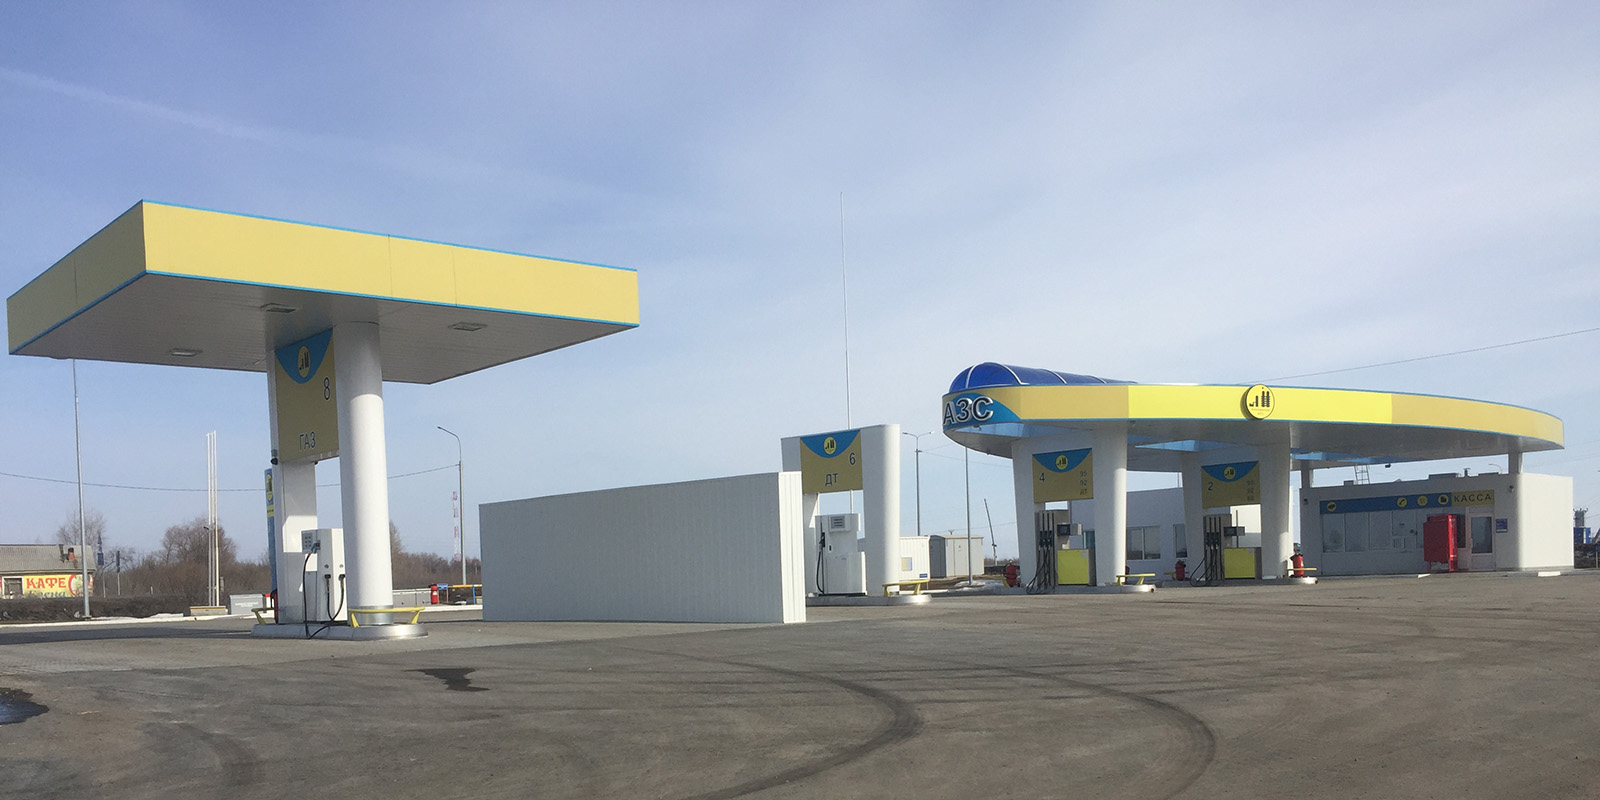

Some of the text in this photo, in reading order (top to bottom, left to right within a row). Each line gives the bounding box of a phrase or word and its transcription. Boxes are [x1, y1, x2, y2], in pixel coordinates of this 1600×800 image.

[323, 376, 331, 401] 8
[943, 395, 994, 426] АЗС
[299, 431, 316, 451] ГАЗ
[849, 452, 856, 466] 6
[824, 472, 839, 486] ДТ
[1039, 472, 1046, 483] 4
[1207, 481, 1214, 491] 2
[1453, 493, 1492, 503] КАССА
[26, 577, 66, 589] КАФЕ
